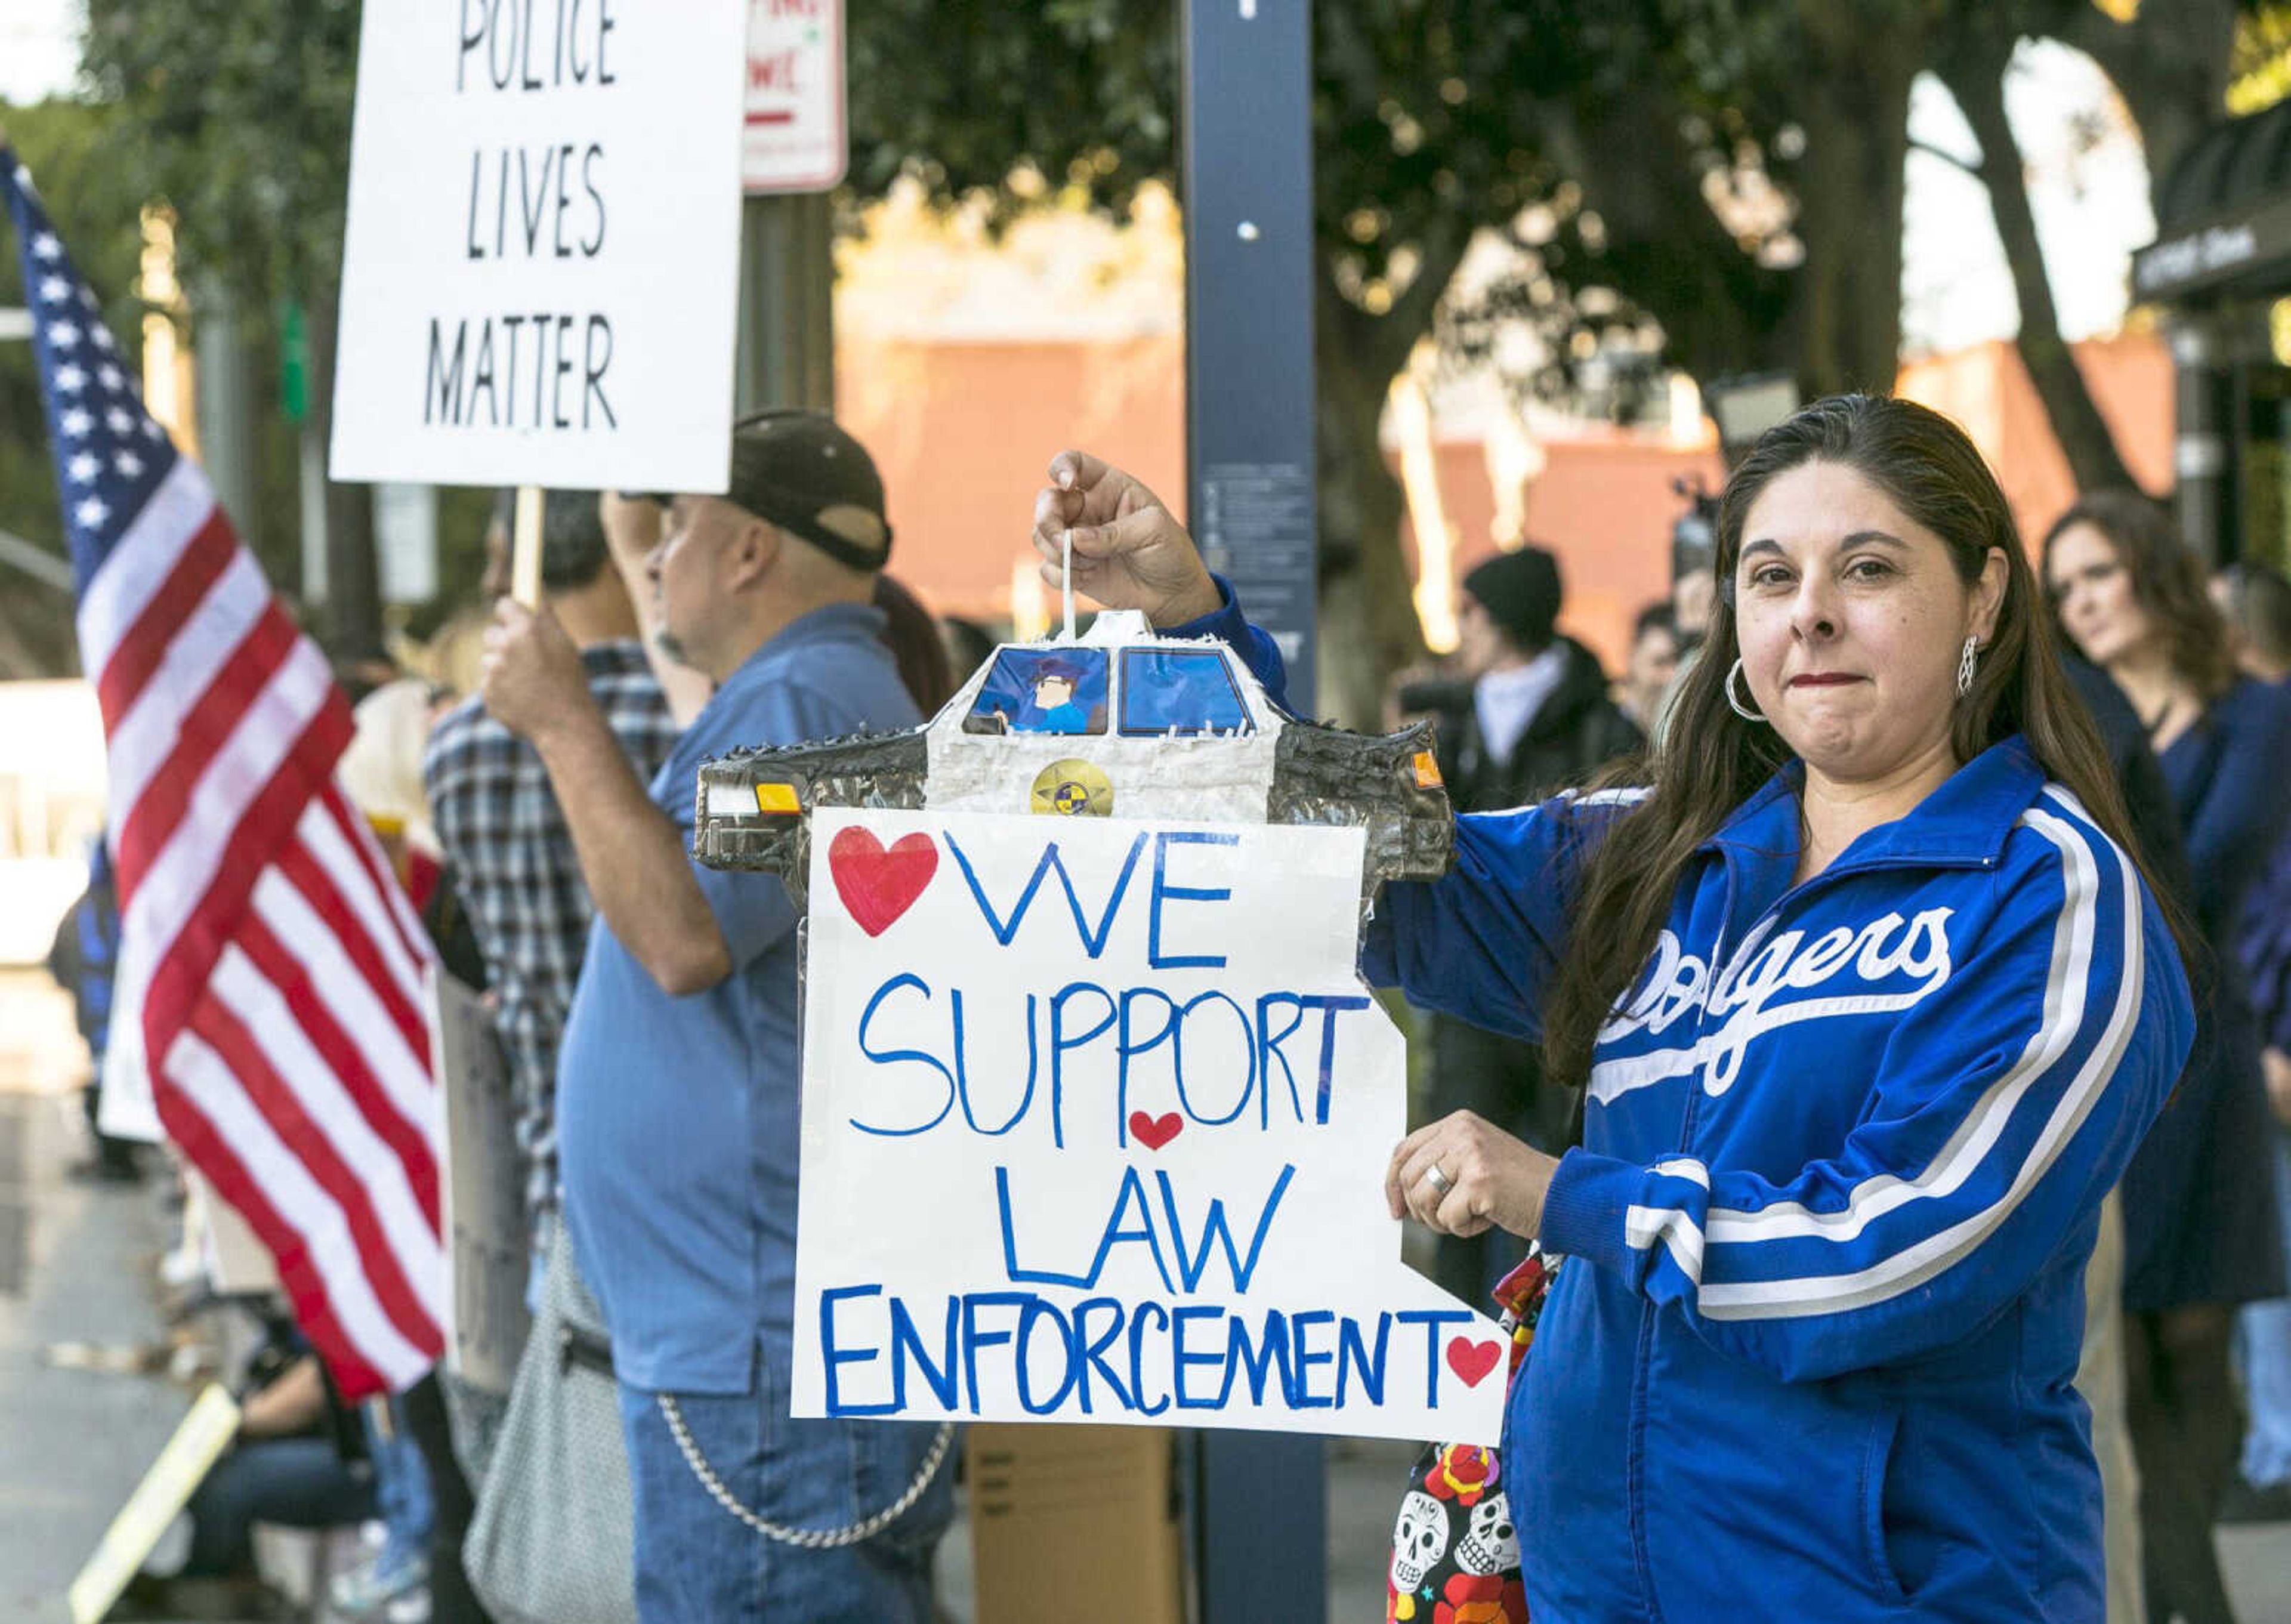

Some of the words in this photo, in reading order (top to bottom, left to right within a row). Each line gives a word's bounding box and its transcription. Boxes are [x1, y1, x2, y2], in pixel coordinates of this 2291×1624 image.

[457, 0, 615, 92] POLICE
[468, 143, 605, 259] LIVES
[424, 314, 617, 430] MATTER
[943, 830, 1240, 970] WE
[849, 972, 1371, 1149] SUPPORT
[995, 1163, 1297, 1295] LAW
[820, 1284, 1475, 1419] ENFORCEMENT
